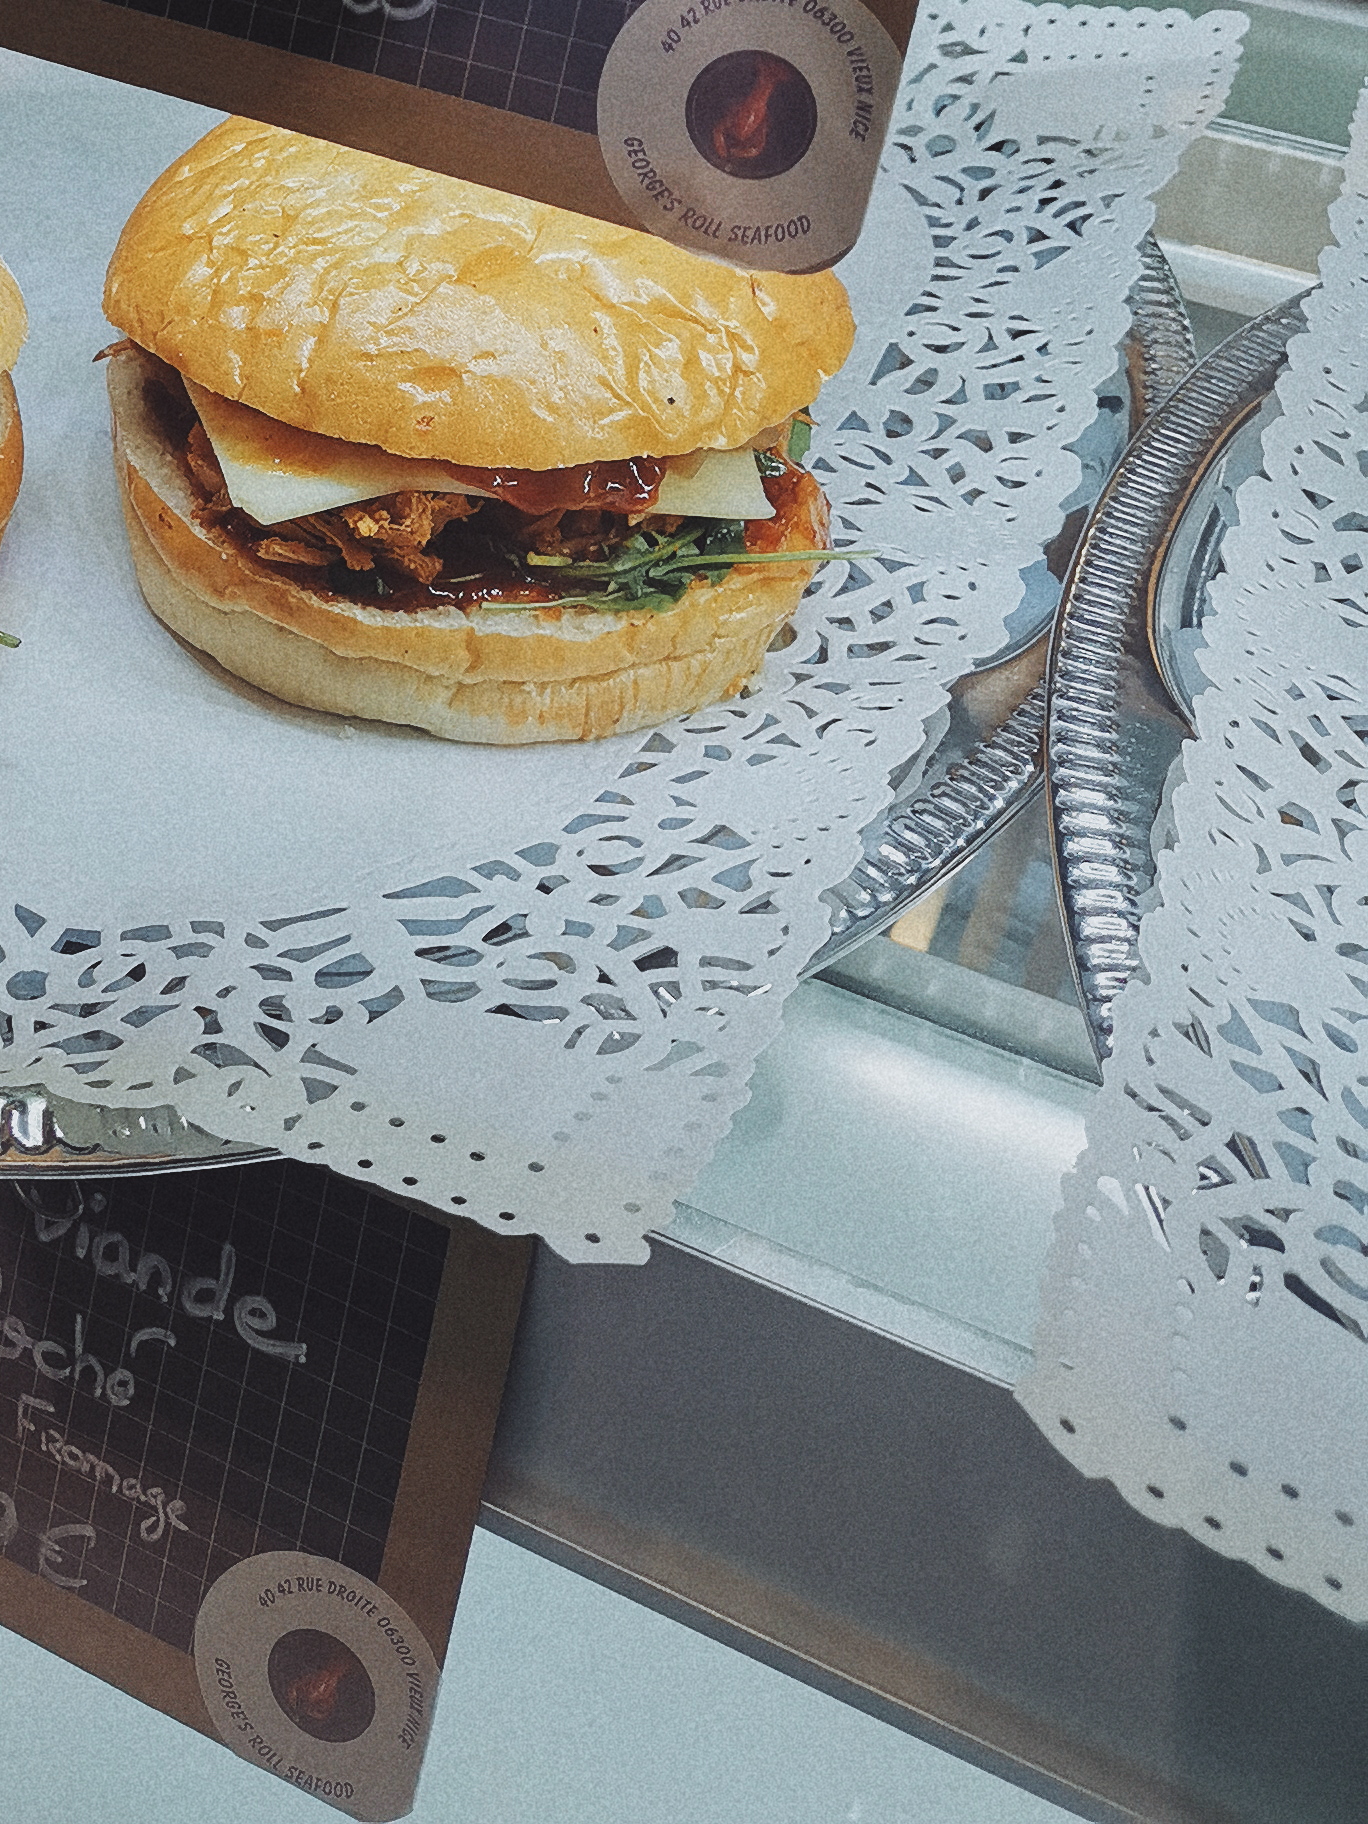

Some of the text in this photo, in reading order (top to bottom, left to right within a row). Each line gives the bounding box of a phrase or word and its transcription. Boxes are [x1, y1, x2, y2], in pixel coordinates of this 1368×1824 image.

[679, 7, 701, 30] 42
[660, 27, 682, 55] 40
[846, 45, 874, 99] VIEUX
[848, 100, 875, 143] NICE
[678, 205, 724, 240] ROLL
[729, 214, 812, 246] SEAFOOD
[258, 1576, 425, 1750] 40 42 RUE DROITE 06300 VIEUX NICE
[248, 1734, 284, 1771] ROLL
[285, 1765, 355, 1799] SEAFOOD
